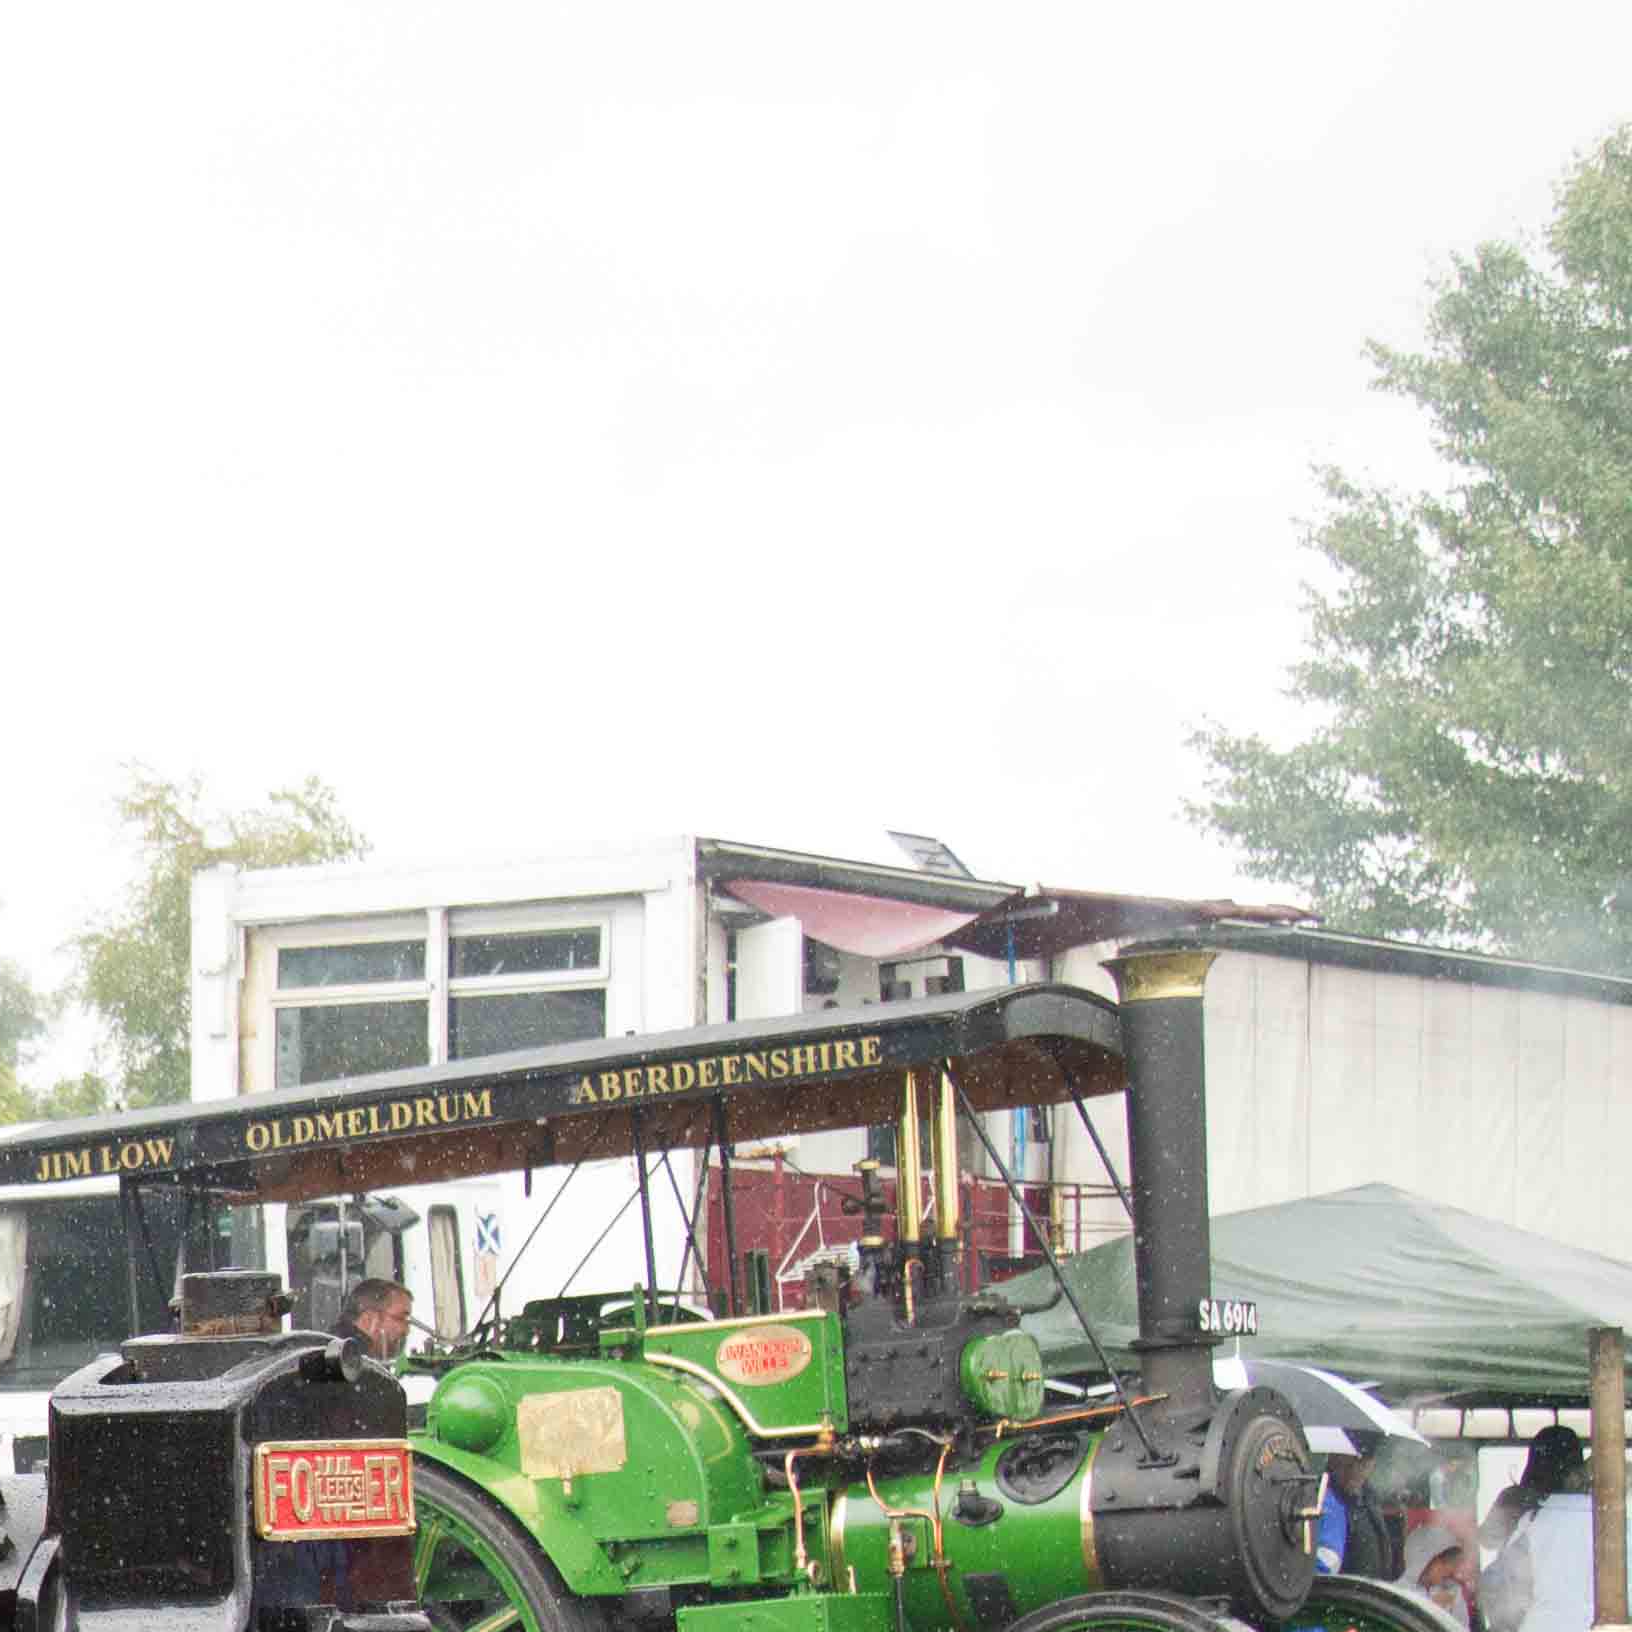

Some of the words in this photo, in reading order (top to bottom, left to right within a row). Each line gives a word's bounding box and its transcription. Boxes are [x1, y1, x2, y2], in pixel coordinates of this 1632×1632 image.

[35, 1149, 92, 1182] JIM
[100, 1138, 175, 1171] LOW
[245, 1089, 494, 1152] OLDMELDRUM
[574, 1035, 883, 1104] ABERDEENSHIRE
[1199, 1299, 1221, 1331] SA
[1223, 1301, 1257, 1333] 6914
[268, 1455, 409, 1524] FOWLER
